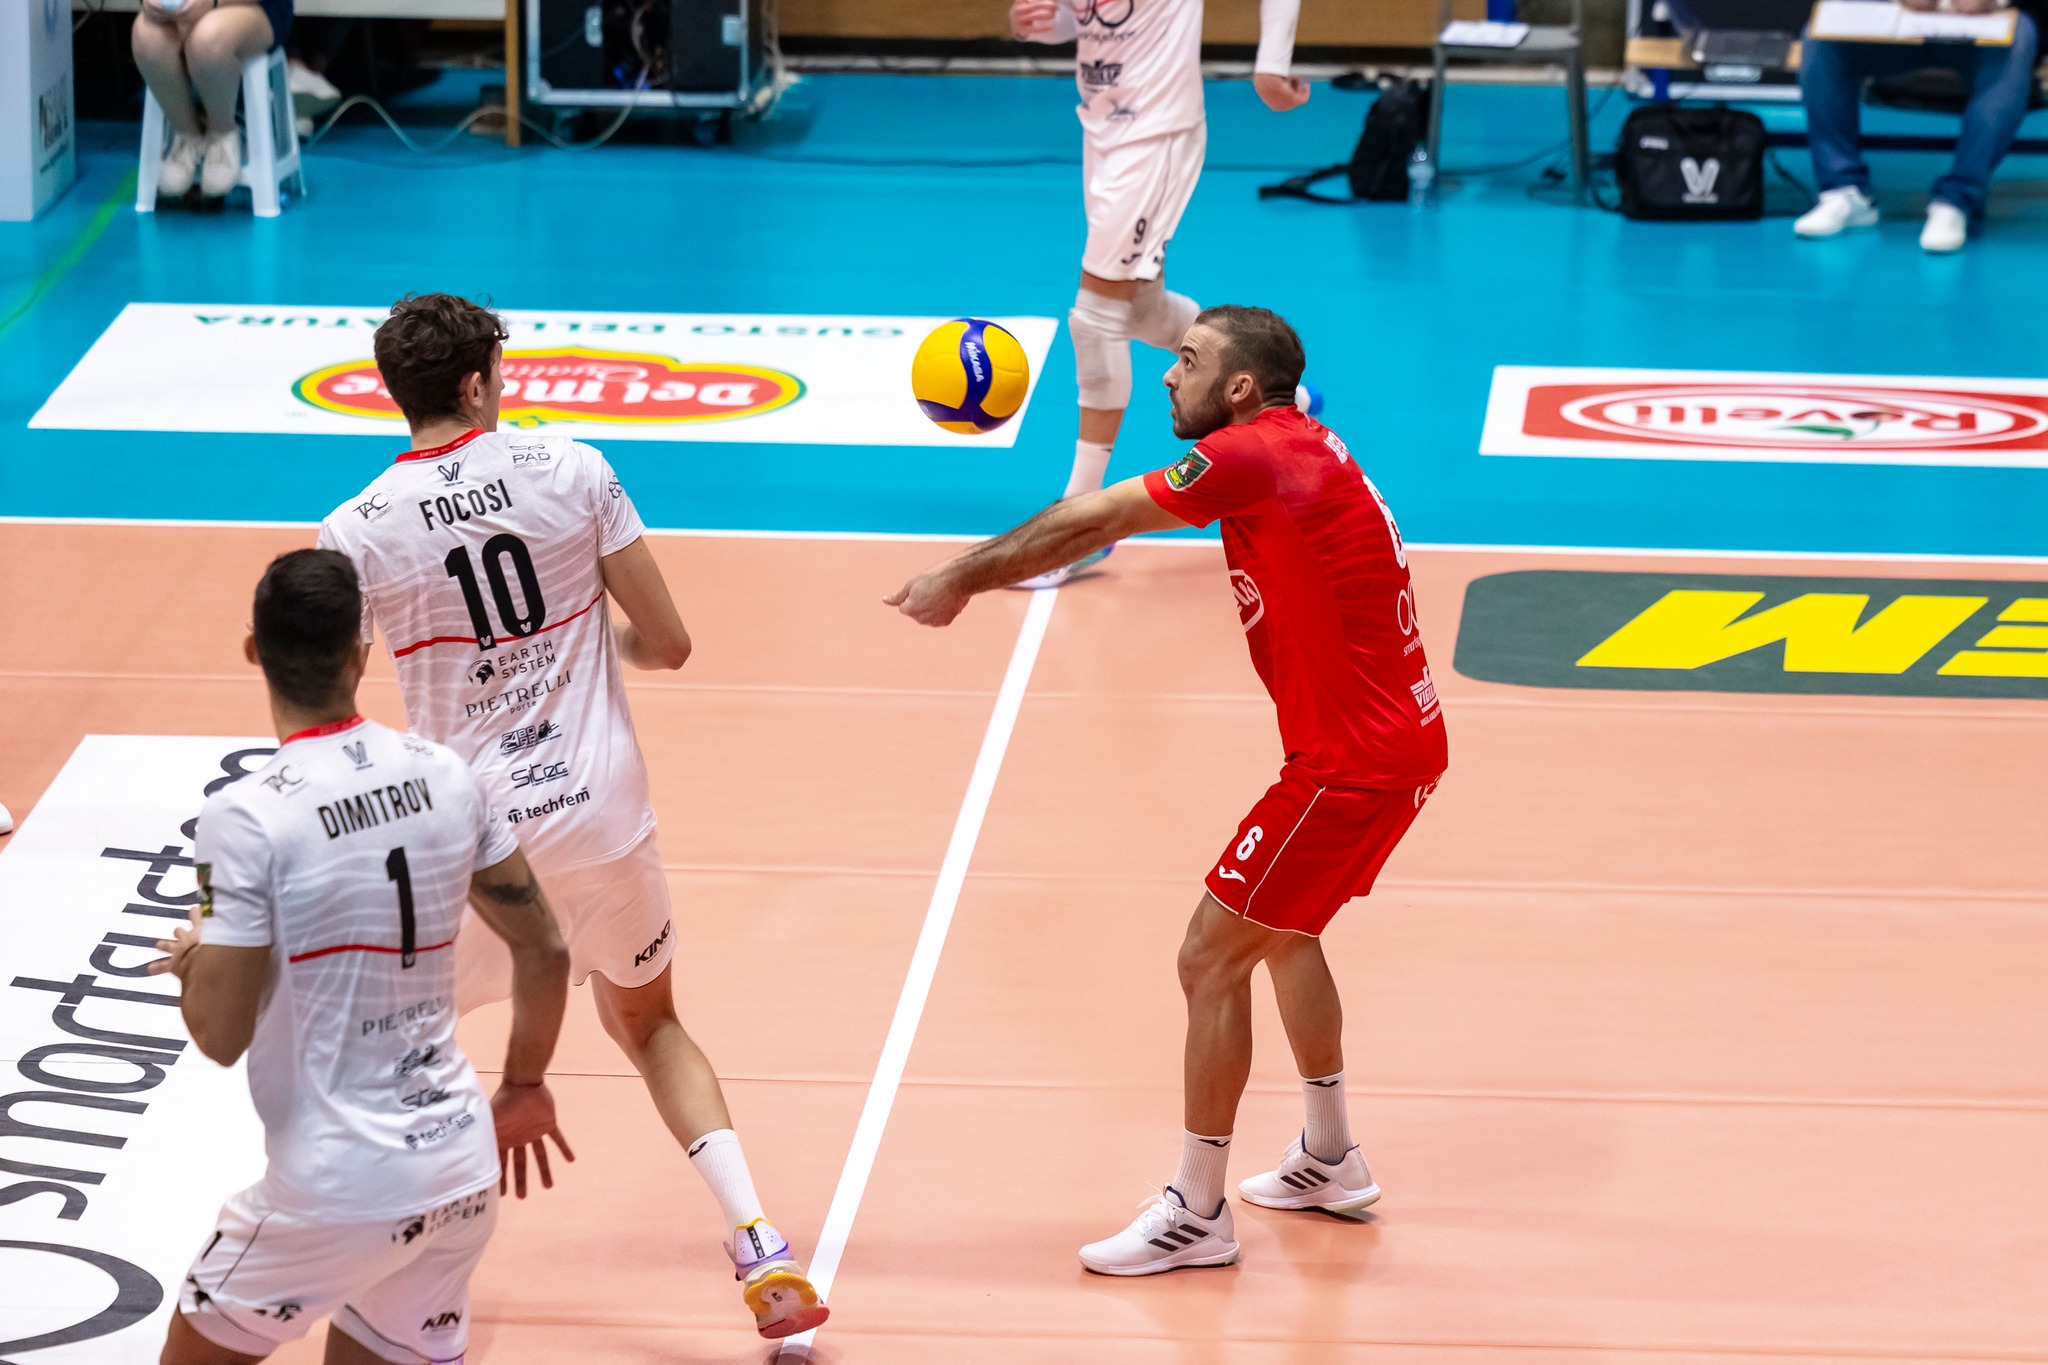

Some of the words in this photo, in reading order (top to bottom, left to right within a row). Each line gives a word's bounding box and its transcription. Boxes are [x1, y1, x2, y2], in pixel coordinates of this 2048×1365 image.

[1133, 217, 1147, 244] 9
[506, 320, 666, 334] DELL
[691, 325, 904, 337] GUSTO
[622, 379, 759, 407] Del
[1634, 403, 1979, 434] Rovelli
[512, 452, 551, 464] PAD
[418, 478, 513, 531] FOCOSI
[444, 532, 546, 651] 10
[498, 640, 553, 667] EARTH
[501, 653, 557, 680] SYSTEM
[465, 669, 572, 718] PIETRELLI
[509, 699, 538, 715] porte
[317, 777, 434, 841] DIMITROV
[1236, 825, 1264, 861] 6
[385, 846, 416, 970] 1
